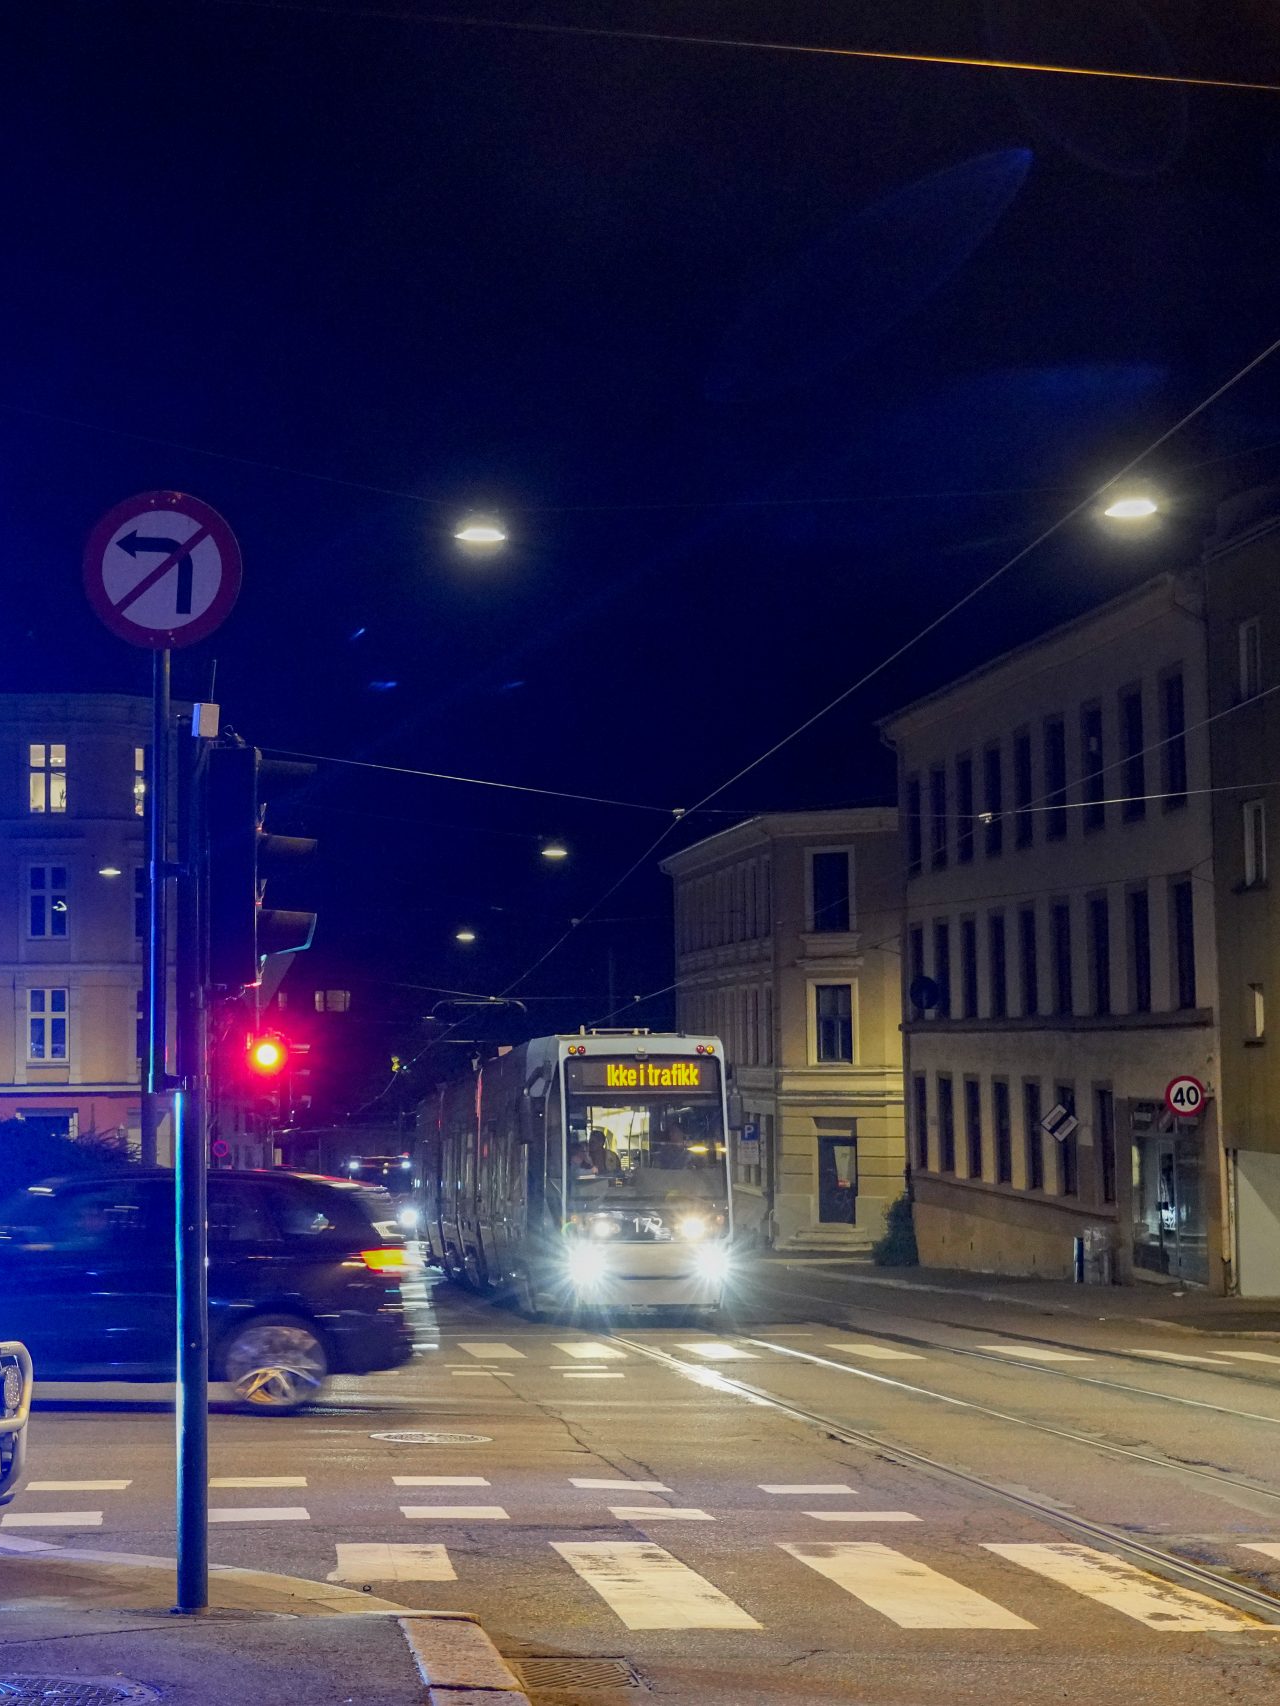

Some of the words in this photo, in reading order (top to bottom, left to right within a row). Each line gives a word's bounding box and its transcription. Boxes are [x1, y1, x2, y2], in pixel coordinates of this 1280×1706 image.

[607, 1063, 637, 1087] Ikke
[639, 1063, 645, 1086] i
[647, 1063, 699, 1087] trafikk
[1173, 1086, 1200, 1107] 40
[744, 1124, 754, 1139] P
